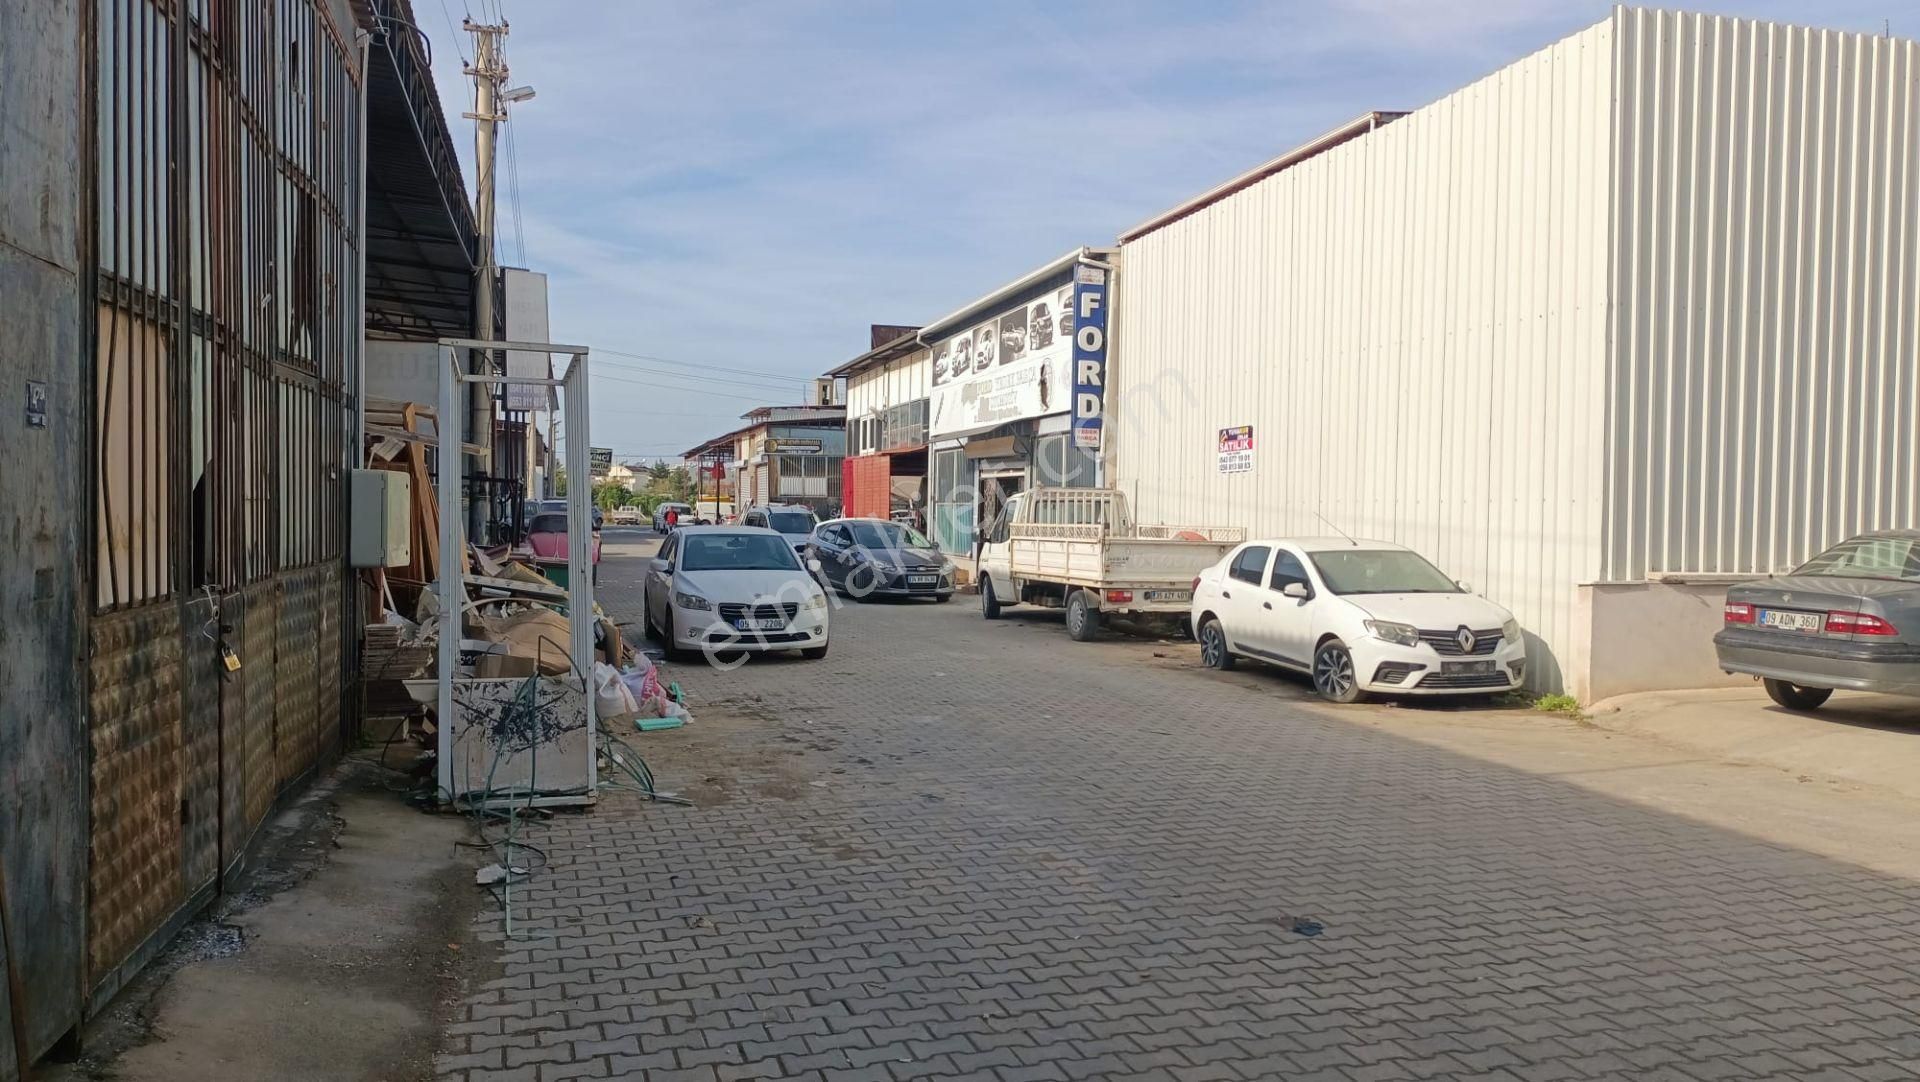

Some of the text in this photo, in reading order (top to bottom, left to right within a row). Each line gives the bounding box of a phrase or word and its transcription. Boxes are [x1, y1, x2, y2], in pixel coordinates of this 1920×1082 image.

[1077, 292, 1103, 418] FORD
[1219, 440, 1249, 452] SATILIK
[1765, 612, 1777, 624] 09
[1778, 613, 1796, 627] ADN
[1799, 615, 1817, 628] 360
